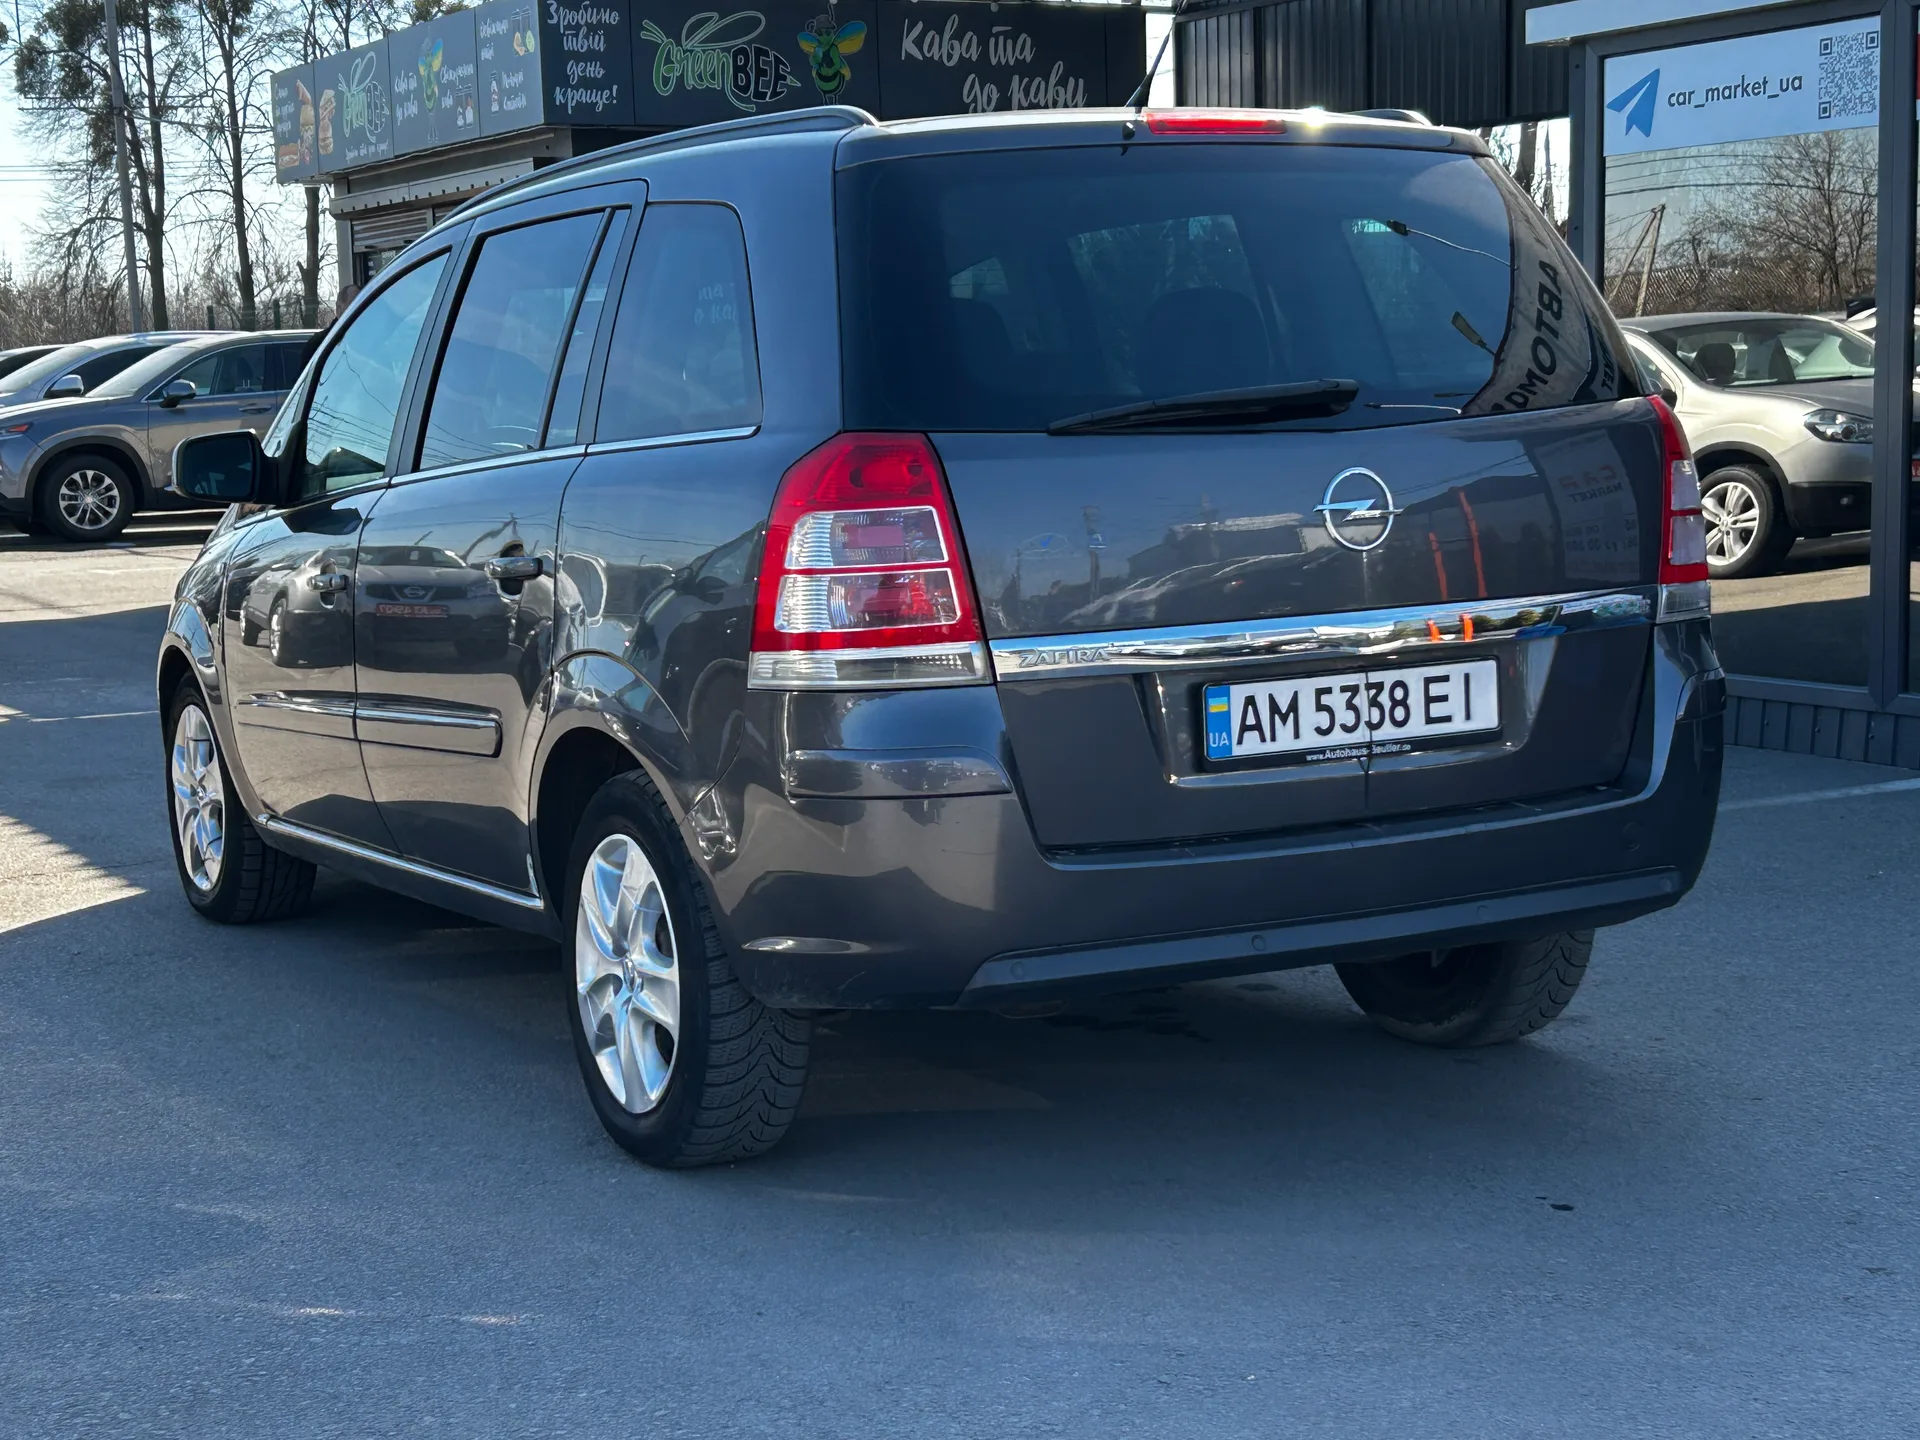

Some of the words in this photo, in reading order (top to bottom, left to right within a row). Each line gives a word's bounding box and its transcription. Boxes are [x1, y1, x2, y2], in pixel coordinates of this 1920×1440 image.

[563, 26, 606, 52] твій
[901, 14, 982, 67] Кава
[989, 26, 1036, 66] та
[567, 60, 606, 85] день
[1008, 60, 1087, 110] кави
[553, 85, 618, 114] краще!
[962, 73, 1000, 114] до
[1667, 75, 1803, 108] car_market_ua
[1018, 647, 1111, 668] ZAFIRA
[1236, 690, 1300, 746] AM
[1313, 679, 1411, 737] 5338
[1423, 672, 1471, 725] EI
[1209, 732, 1230, 748] UA
